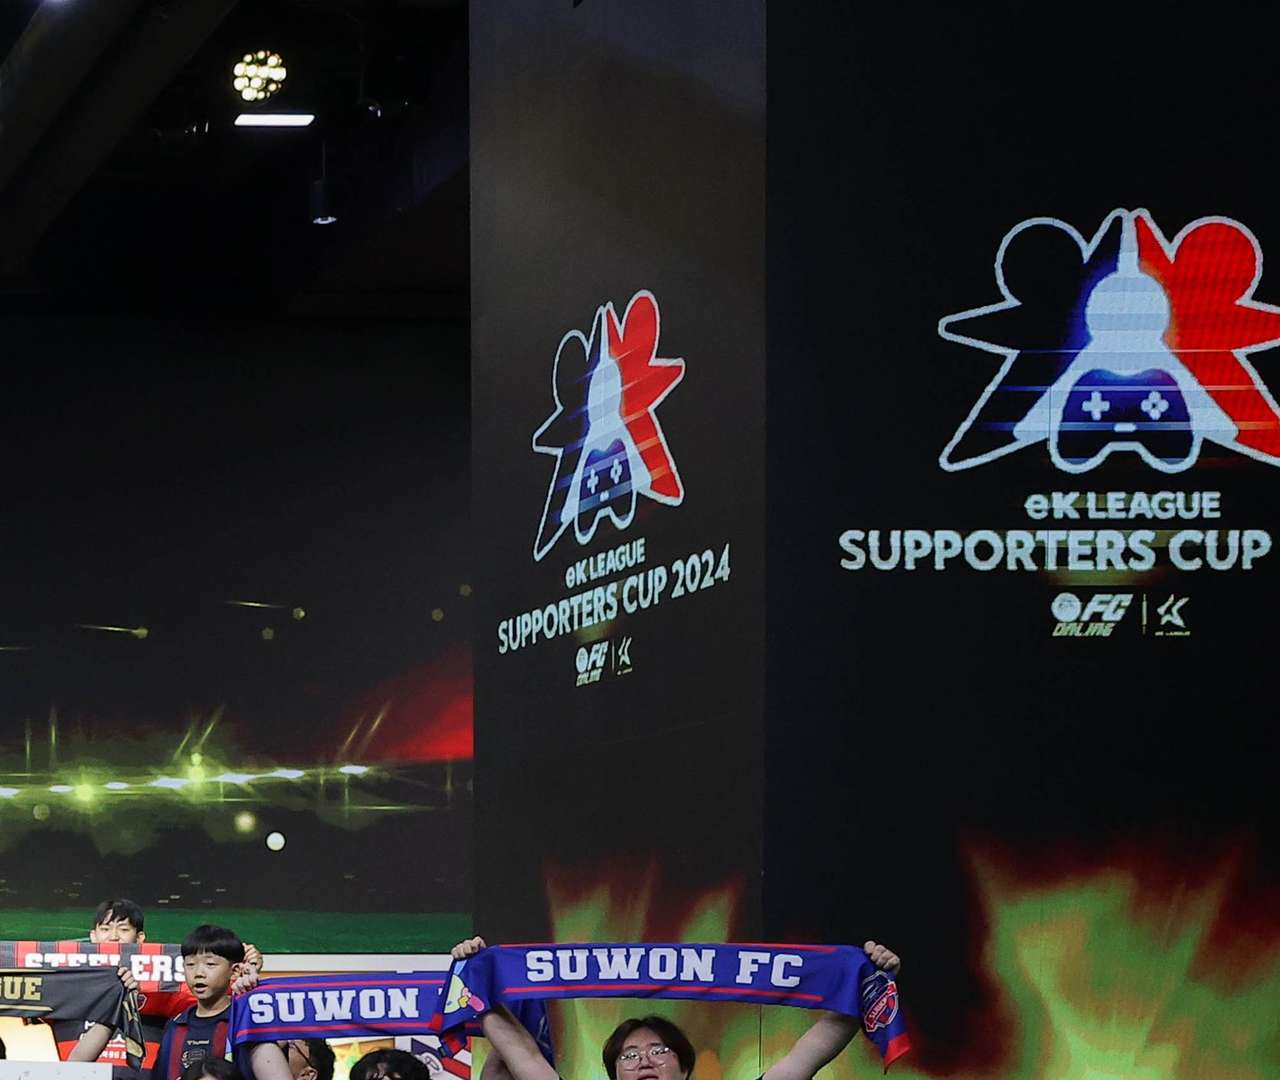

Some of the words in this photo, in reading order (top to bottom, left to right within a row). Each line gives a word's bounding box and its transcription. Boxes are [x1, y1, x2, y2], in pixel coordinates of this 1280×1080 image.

[1087, 490, 1222, 520] LEAGUE
[589, 537, 647, 582] LEAGUE
[840, 529, 1156, 572] SUPPORTERS
[1169, 529, 1272, 571] CUP
[497, 579, 619, 655] SUPPORTERS
[622, 566, 668, 612] CUP
[671, 543, 732, 600] 2024
[1079, 593, 1134, 621] FC
[526, 948, 717, 984] SUWON
[735, 951, 804, 988] FC
[249, 987, 421, 1025] SUWON
